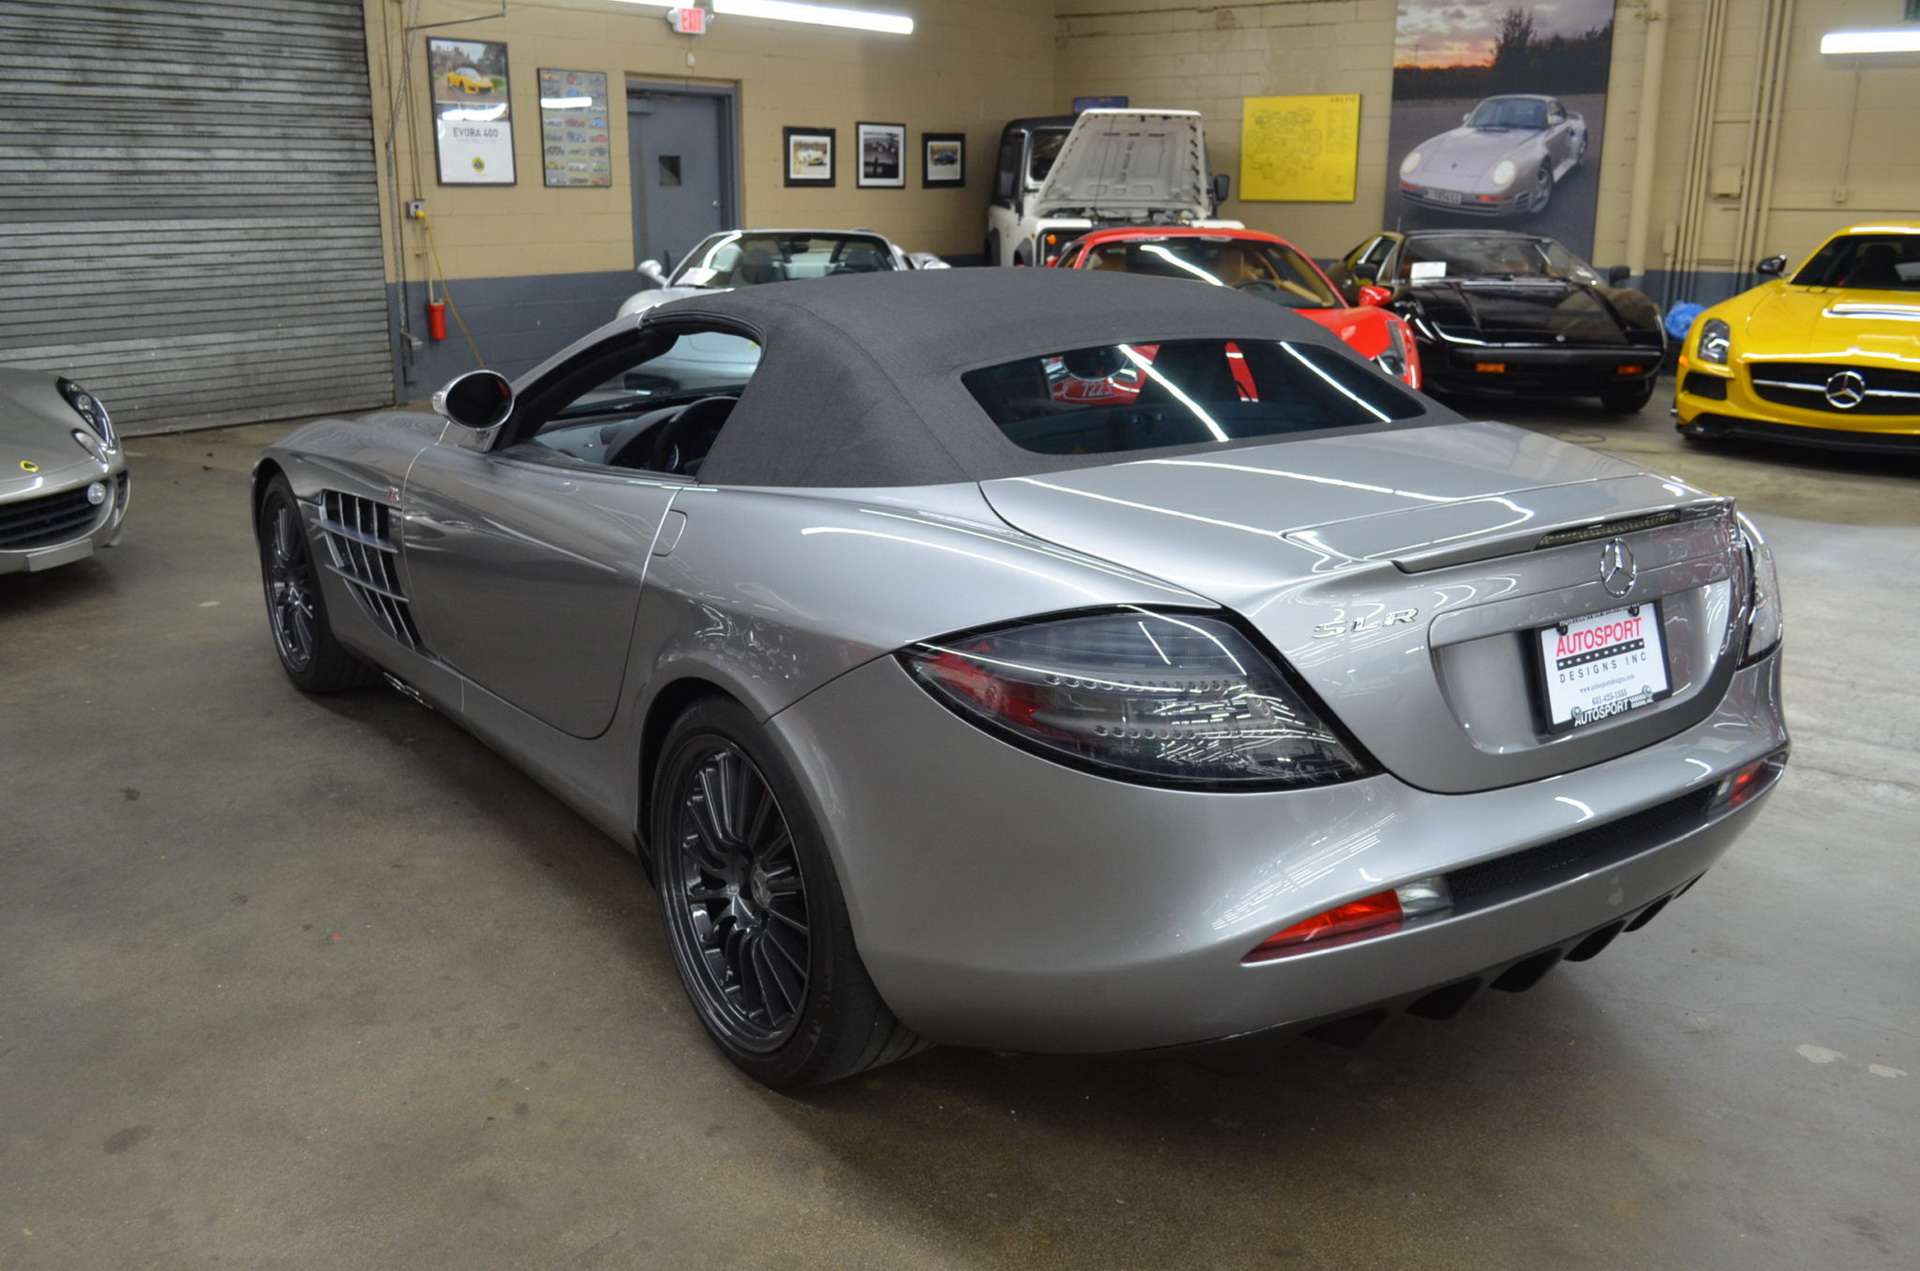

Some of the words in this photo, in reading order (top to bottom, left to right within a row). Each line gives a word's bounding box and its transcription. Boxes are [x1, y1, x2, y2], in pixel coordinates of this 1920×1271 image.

[681, 9, 703, 32] EXIT
[453, 127, 481, 138] EVORA
[483, 128, 499, 138] 400
[1312, 607, 1419, 638] SLR
[1556, 617, 1643, 657] AUTOSPORT
[1560, 659, 1618, 684] DESIGNS
[1625, 652, 1648, 666] INC
